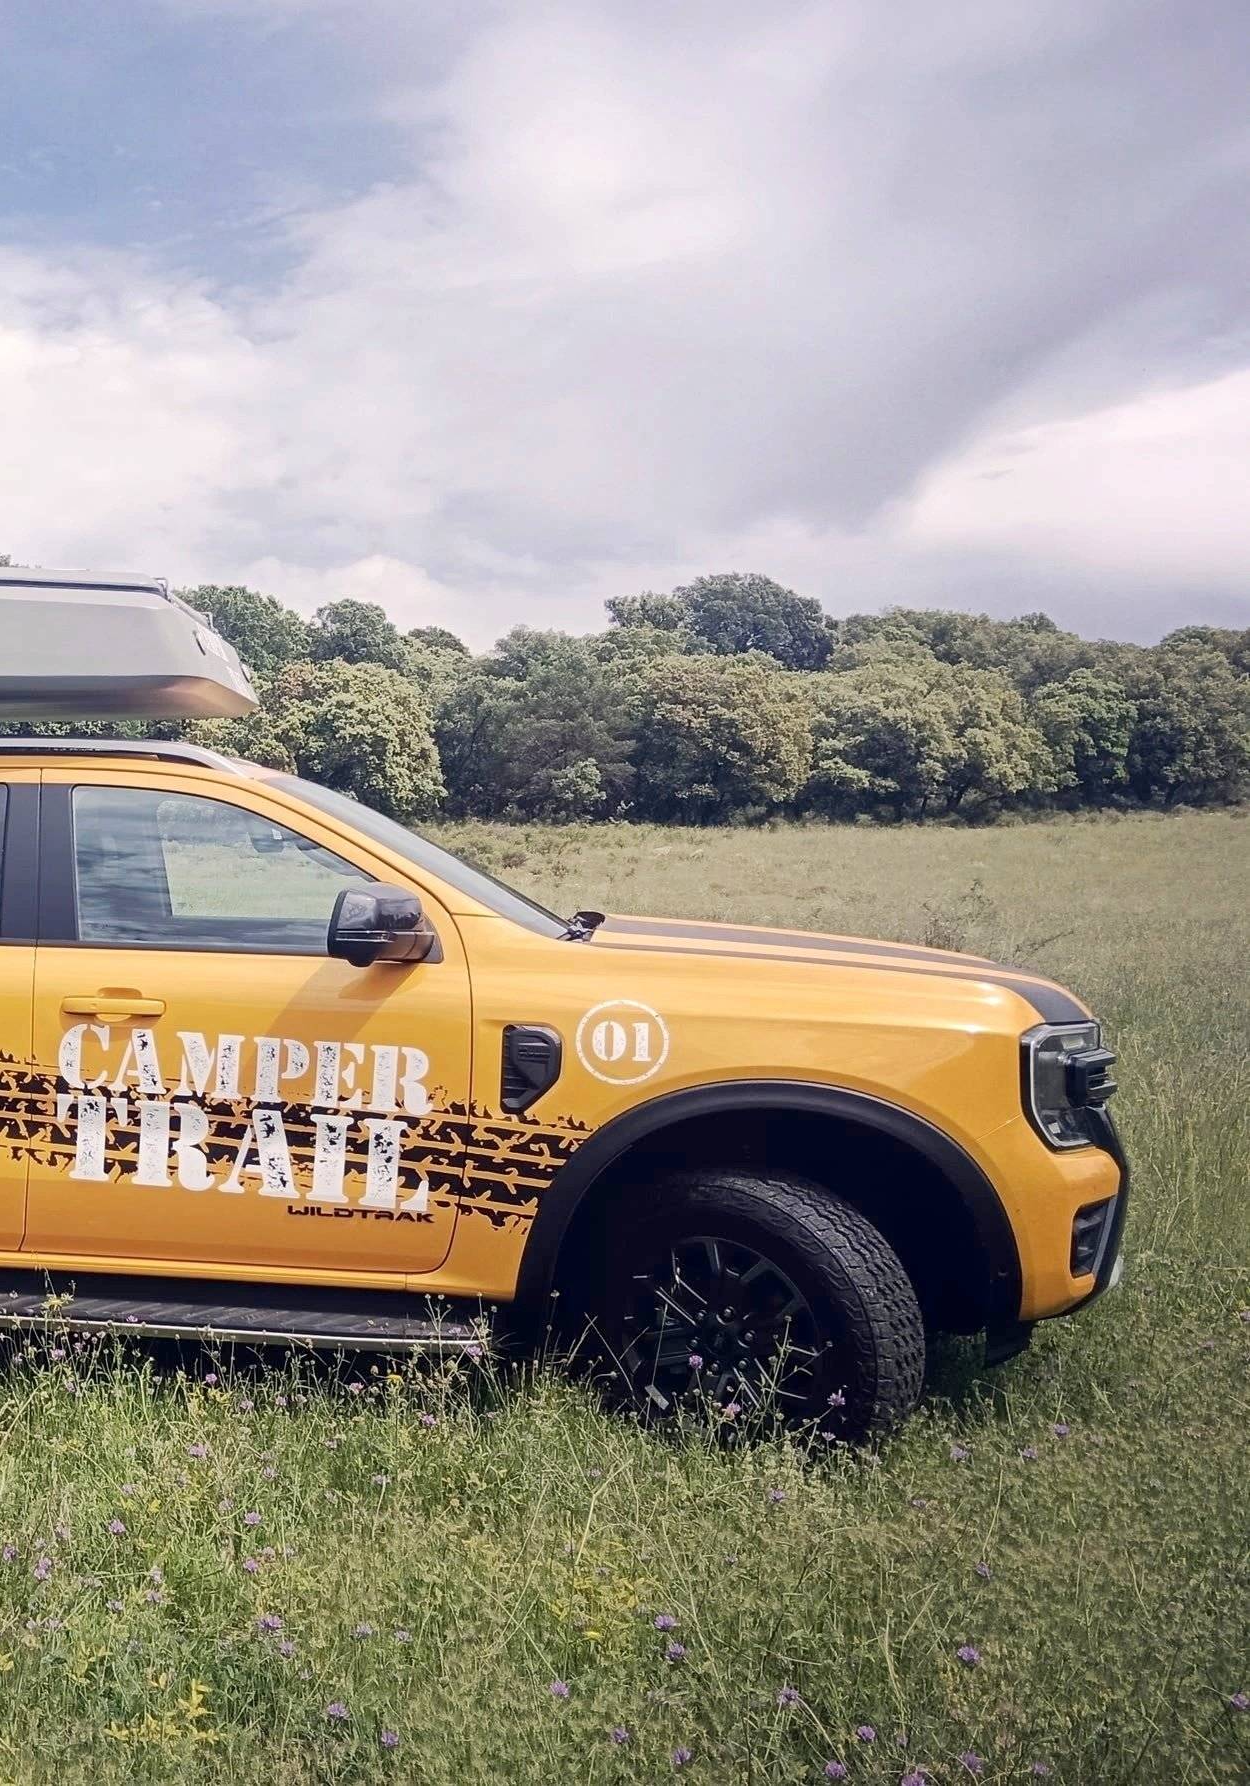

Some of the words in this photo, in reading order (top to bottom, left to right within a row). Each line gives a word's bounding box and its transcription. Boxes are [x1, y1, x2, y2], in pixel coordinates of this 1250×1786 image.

[58, 1023, 434, 1116] CAMPER
[591, 1020, 652, 1062] 01
[56, 1093, 430, 1212] TRAIL
[287, 1205, 435, 1224] WILDTRAK
